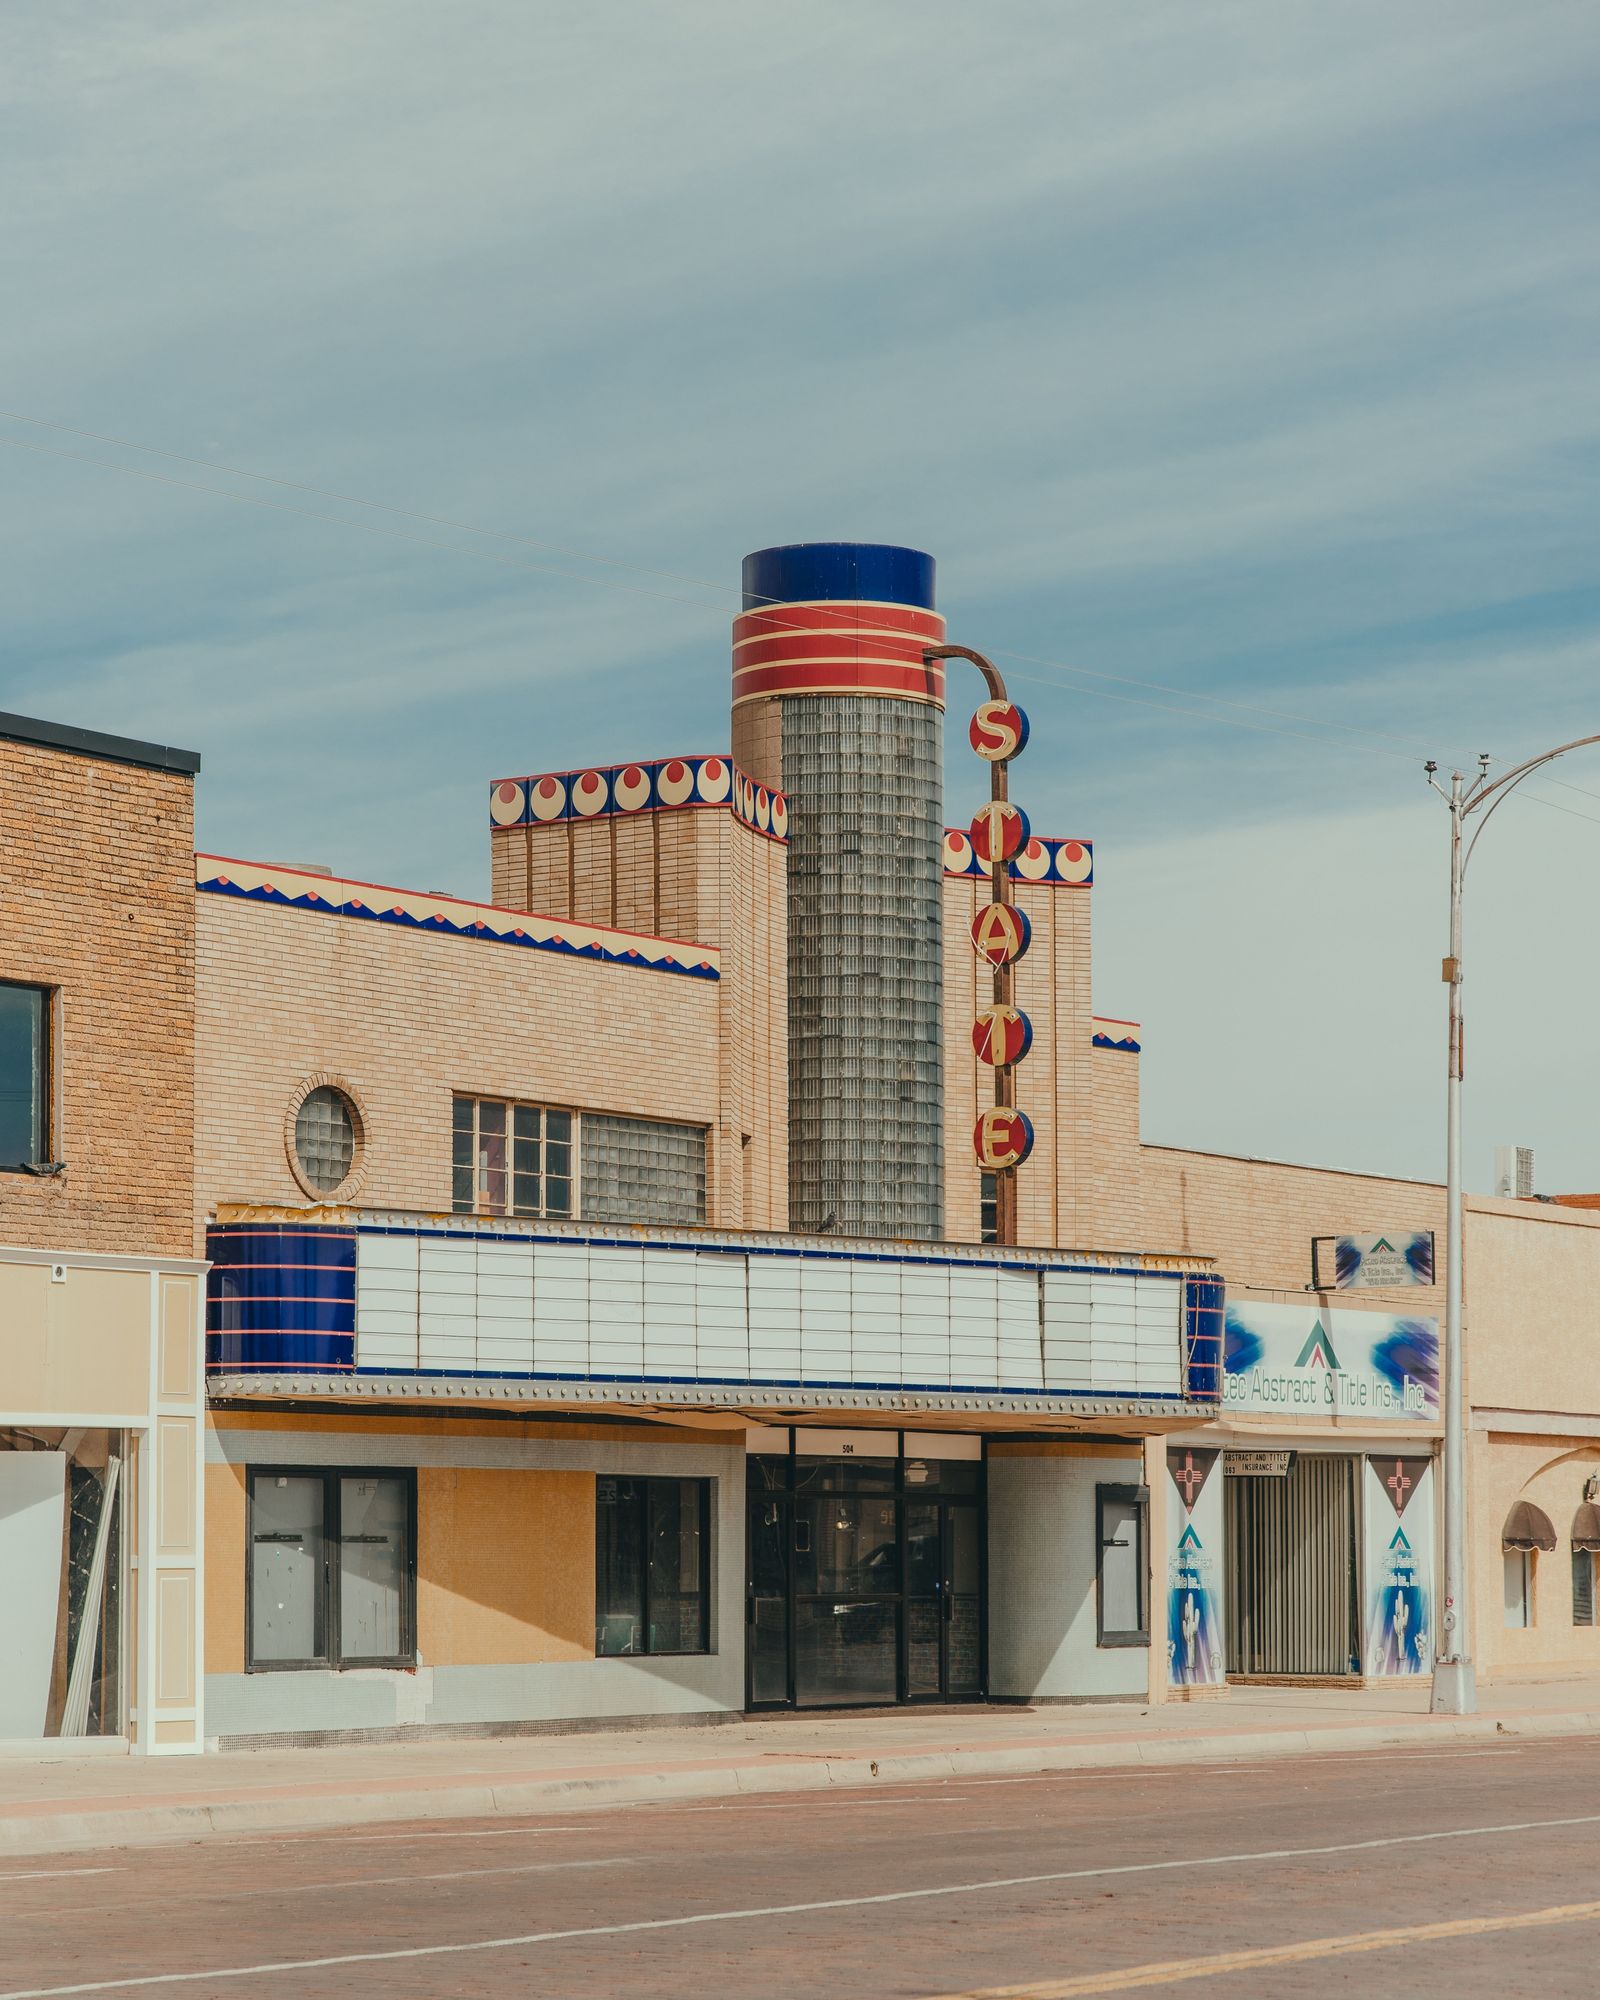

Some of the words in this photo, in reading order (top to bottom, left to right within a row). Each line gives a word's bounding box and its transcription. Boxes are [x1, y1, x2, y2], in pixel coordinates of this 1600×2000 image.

[975, 701, 1019, 1167] STATE
[1223, 1369, 1247, 1400] tec
[1251, 1369, 1316, 1404] Abstract
[1324, 1372, 1334, 1404] &
[1338, 1373, 1367, 1406] Title
[1403, 1375, 1427, 1410] Inc.
[842, 1444, 854, 1454] 504
[1225, 1453, 1252, 1461] ABSTRACT
[1270, 1453, 1287, 1461] TITLE
[1242, 1463, 1273, 1471] INSURANCE
[1277, 1463, 1287, 1471] INC
